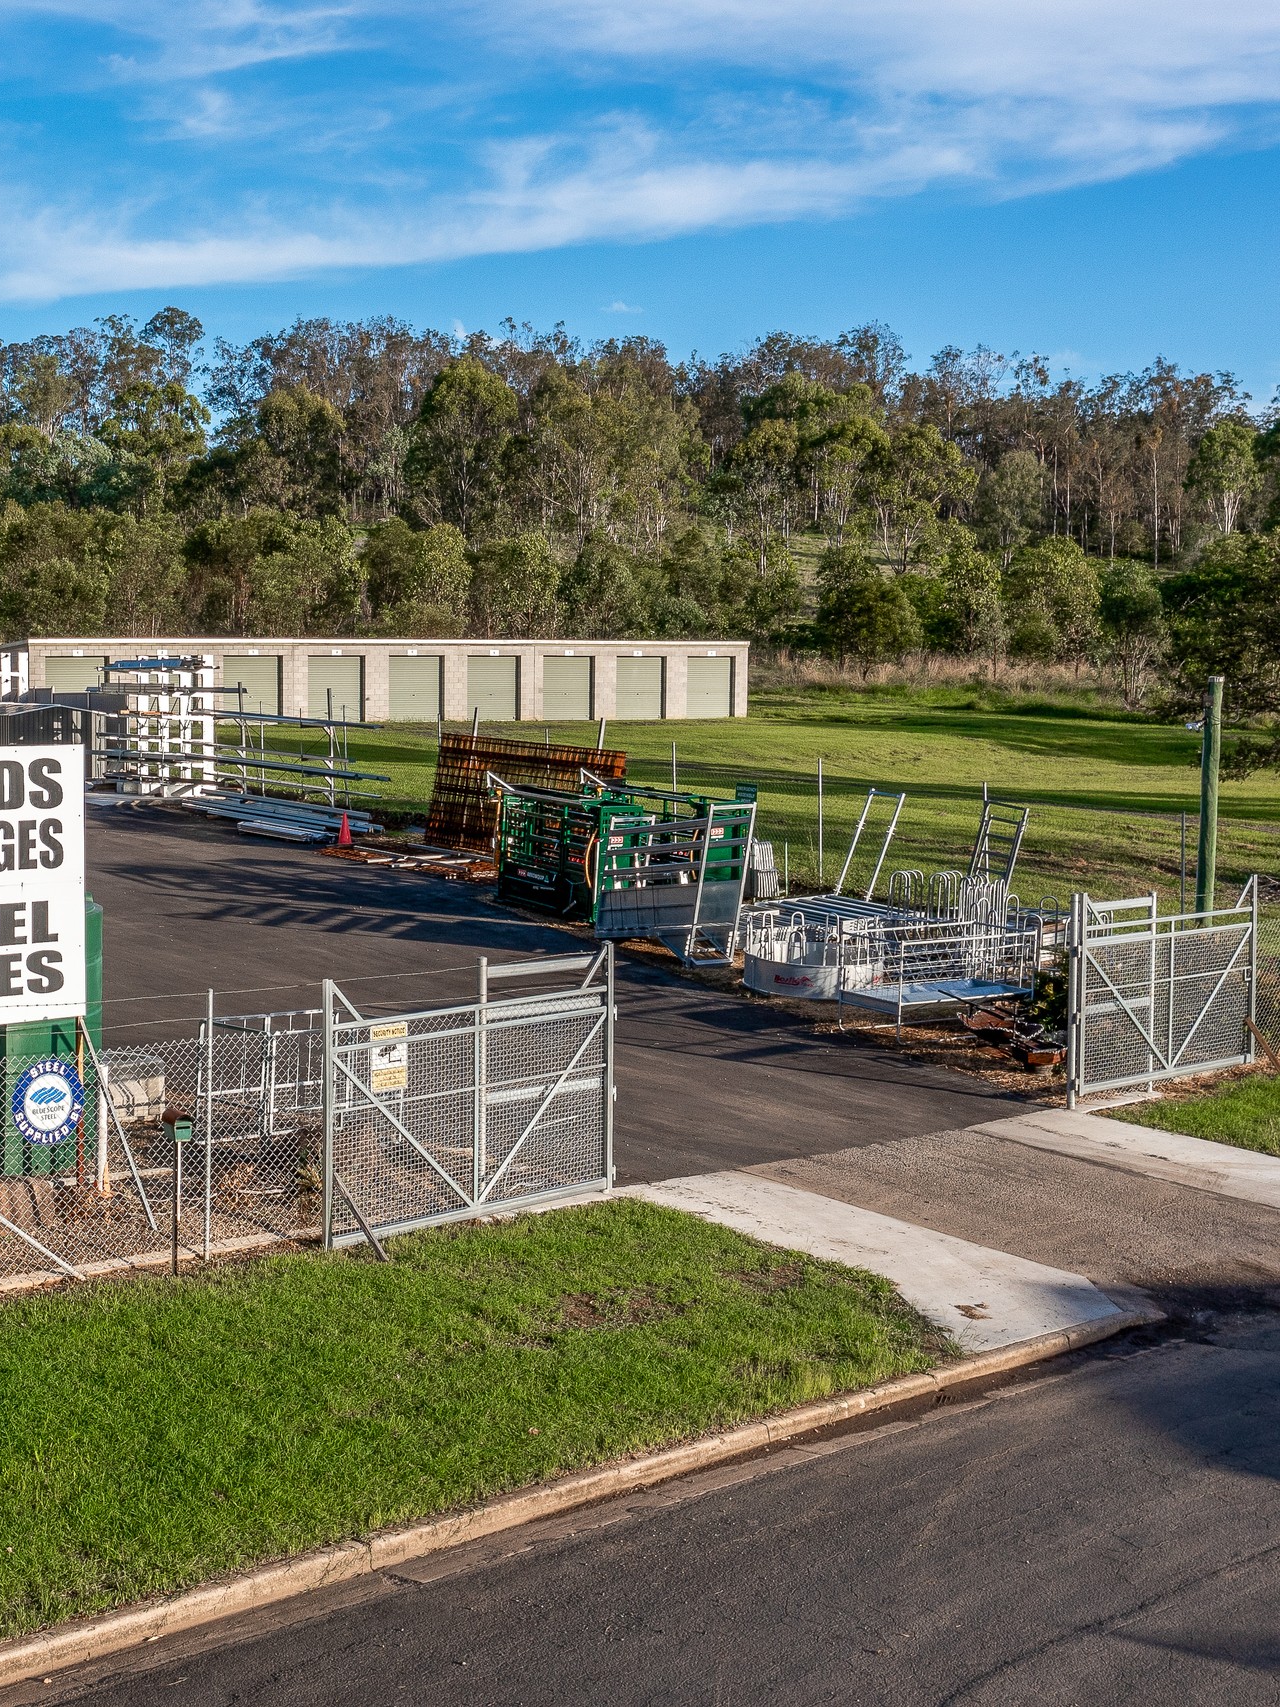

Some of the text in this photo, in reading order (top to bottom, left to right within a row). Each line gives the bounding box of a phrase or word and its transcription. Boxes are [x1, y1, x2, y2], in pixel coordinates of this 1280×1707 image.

[29, 1061, 66, 1079] STEEL
[14, 1102, 83, 1143] SUPPLIED BY
